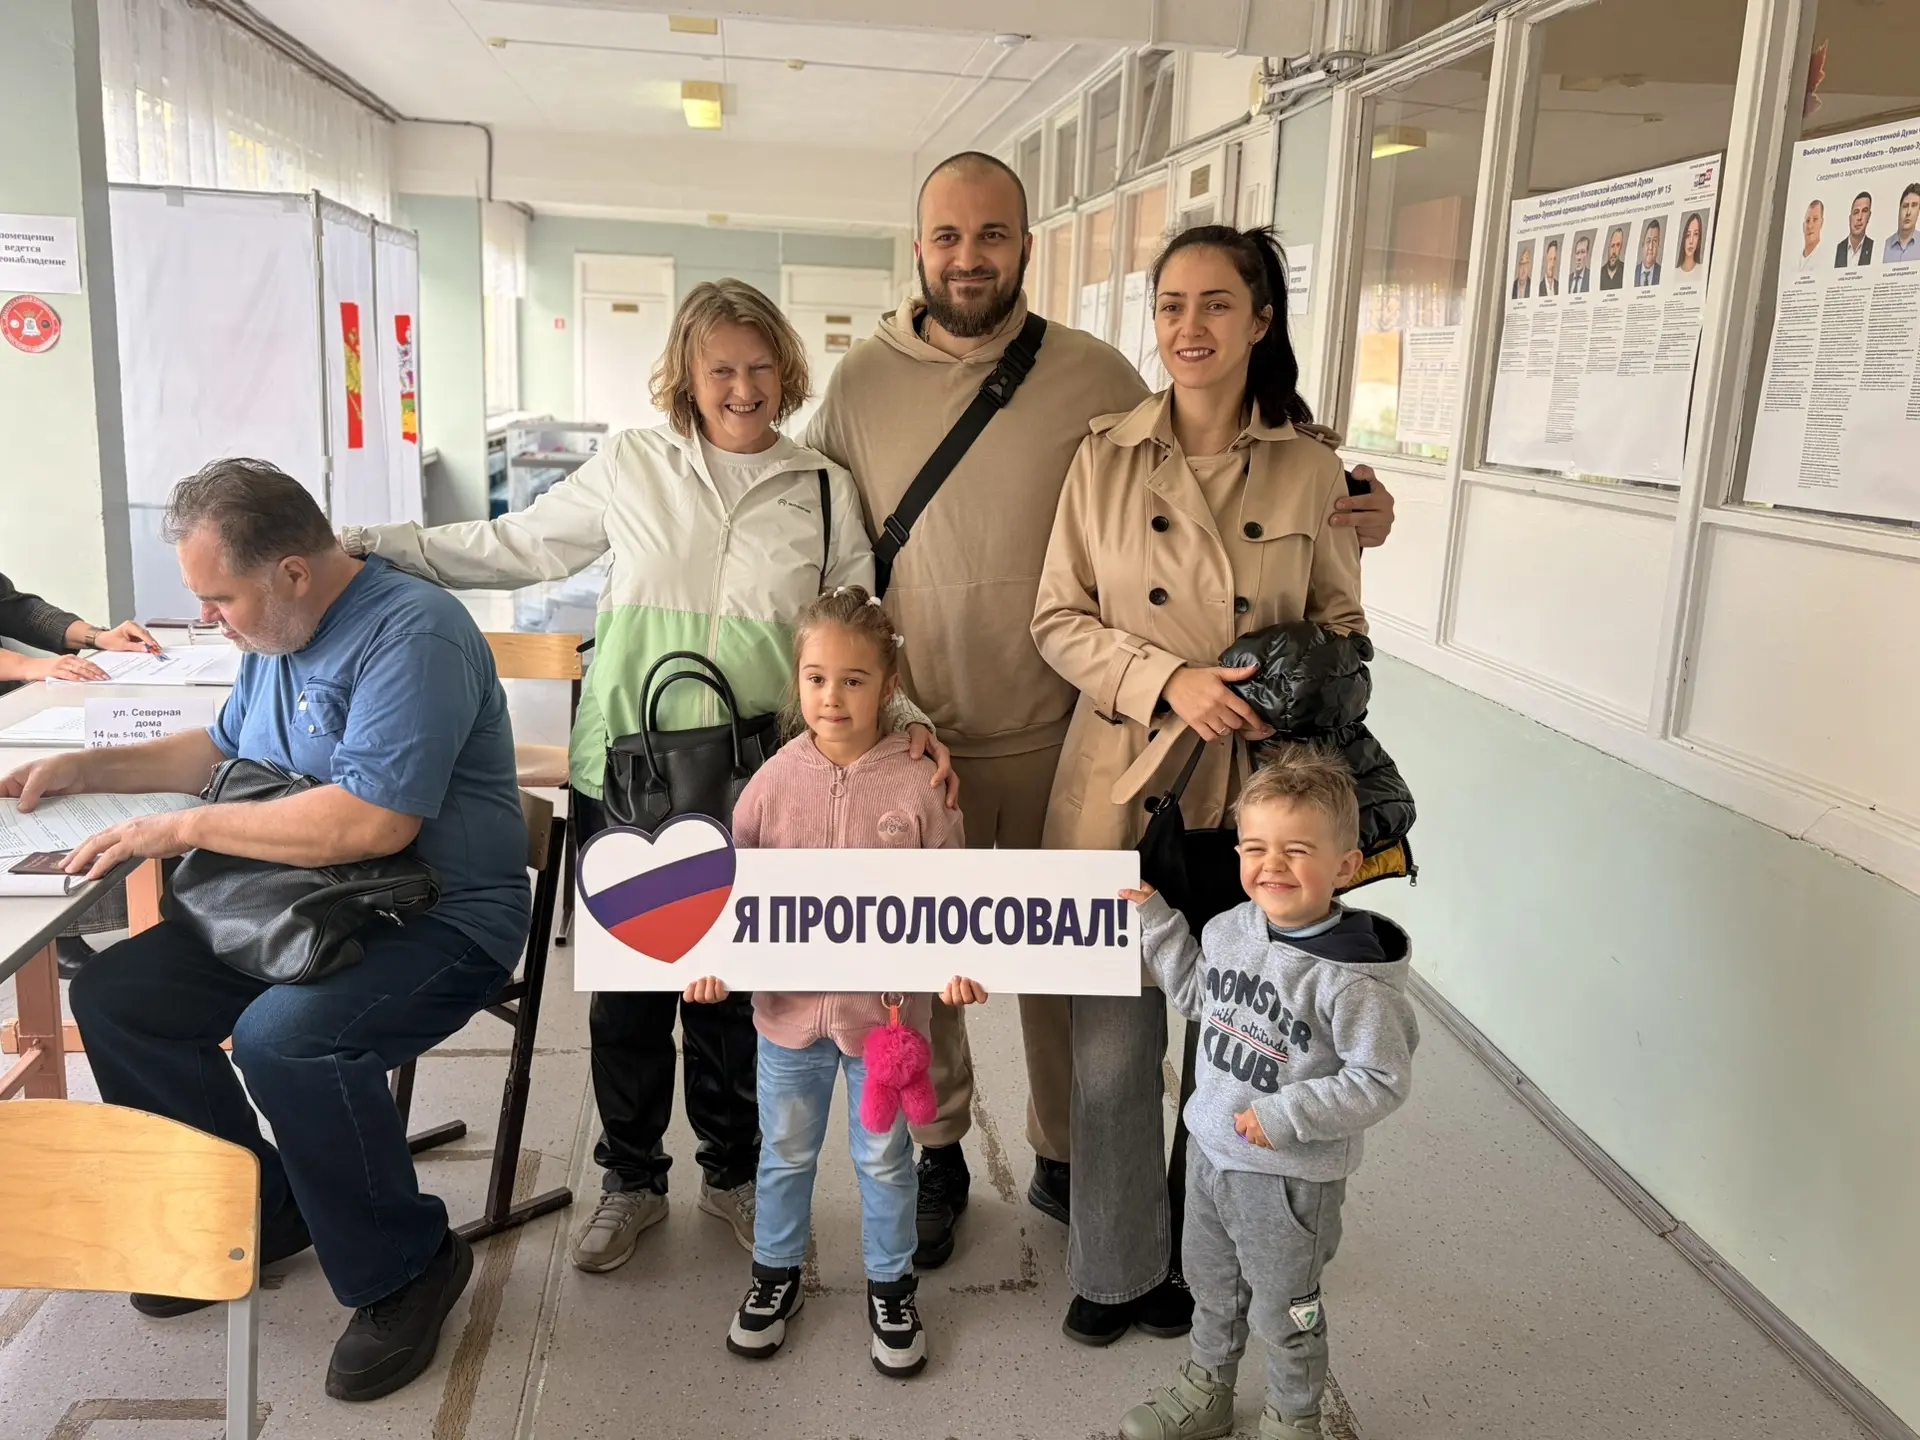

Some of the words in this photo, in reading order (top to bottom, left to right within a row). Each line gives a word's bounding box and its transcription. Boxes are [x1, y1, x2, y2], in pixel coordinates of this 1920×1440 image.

[1802, 146, 1826, 156] Выборы
[1826, 142, 1853, 153] депутатов
[1854, 130, 1900, 147] Государственной
[1900, 128, 1918, 138] Думы
[1830, 154, 1862, 164] Московская
[1862, 150, 1884, 159] область
[1816, 171, 1839, 182] Сведения
[1844, 162, 1898, 176] зарегистрированных
[1580, 184, 1609, 199] Московской
[1610, 179, 1637, 192] областной
[1637, 177, 1653, 188] Думы
[1641, 189, 1657, 200] округ
[1665, 184, 1672, 194] 15
[4, 244, 41, 253] ведется
[588, 438, 598, 452] 2
[112, 710, 129, 718] ул.
[132, 708, 181, 717] Северная
[150, 730, 161, 738] 16
[732, 897, 759, 944] Я
[770, 896, 1129, 948] ПРОГОЛОСОВАЛ!
[1212, 1008, 1237, 1028] with
[1241, 1022, 1288, 1056] attitude
[1204, 1026, 1279, 1093] CLUB
